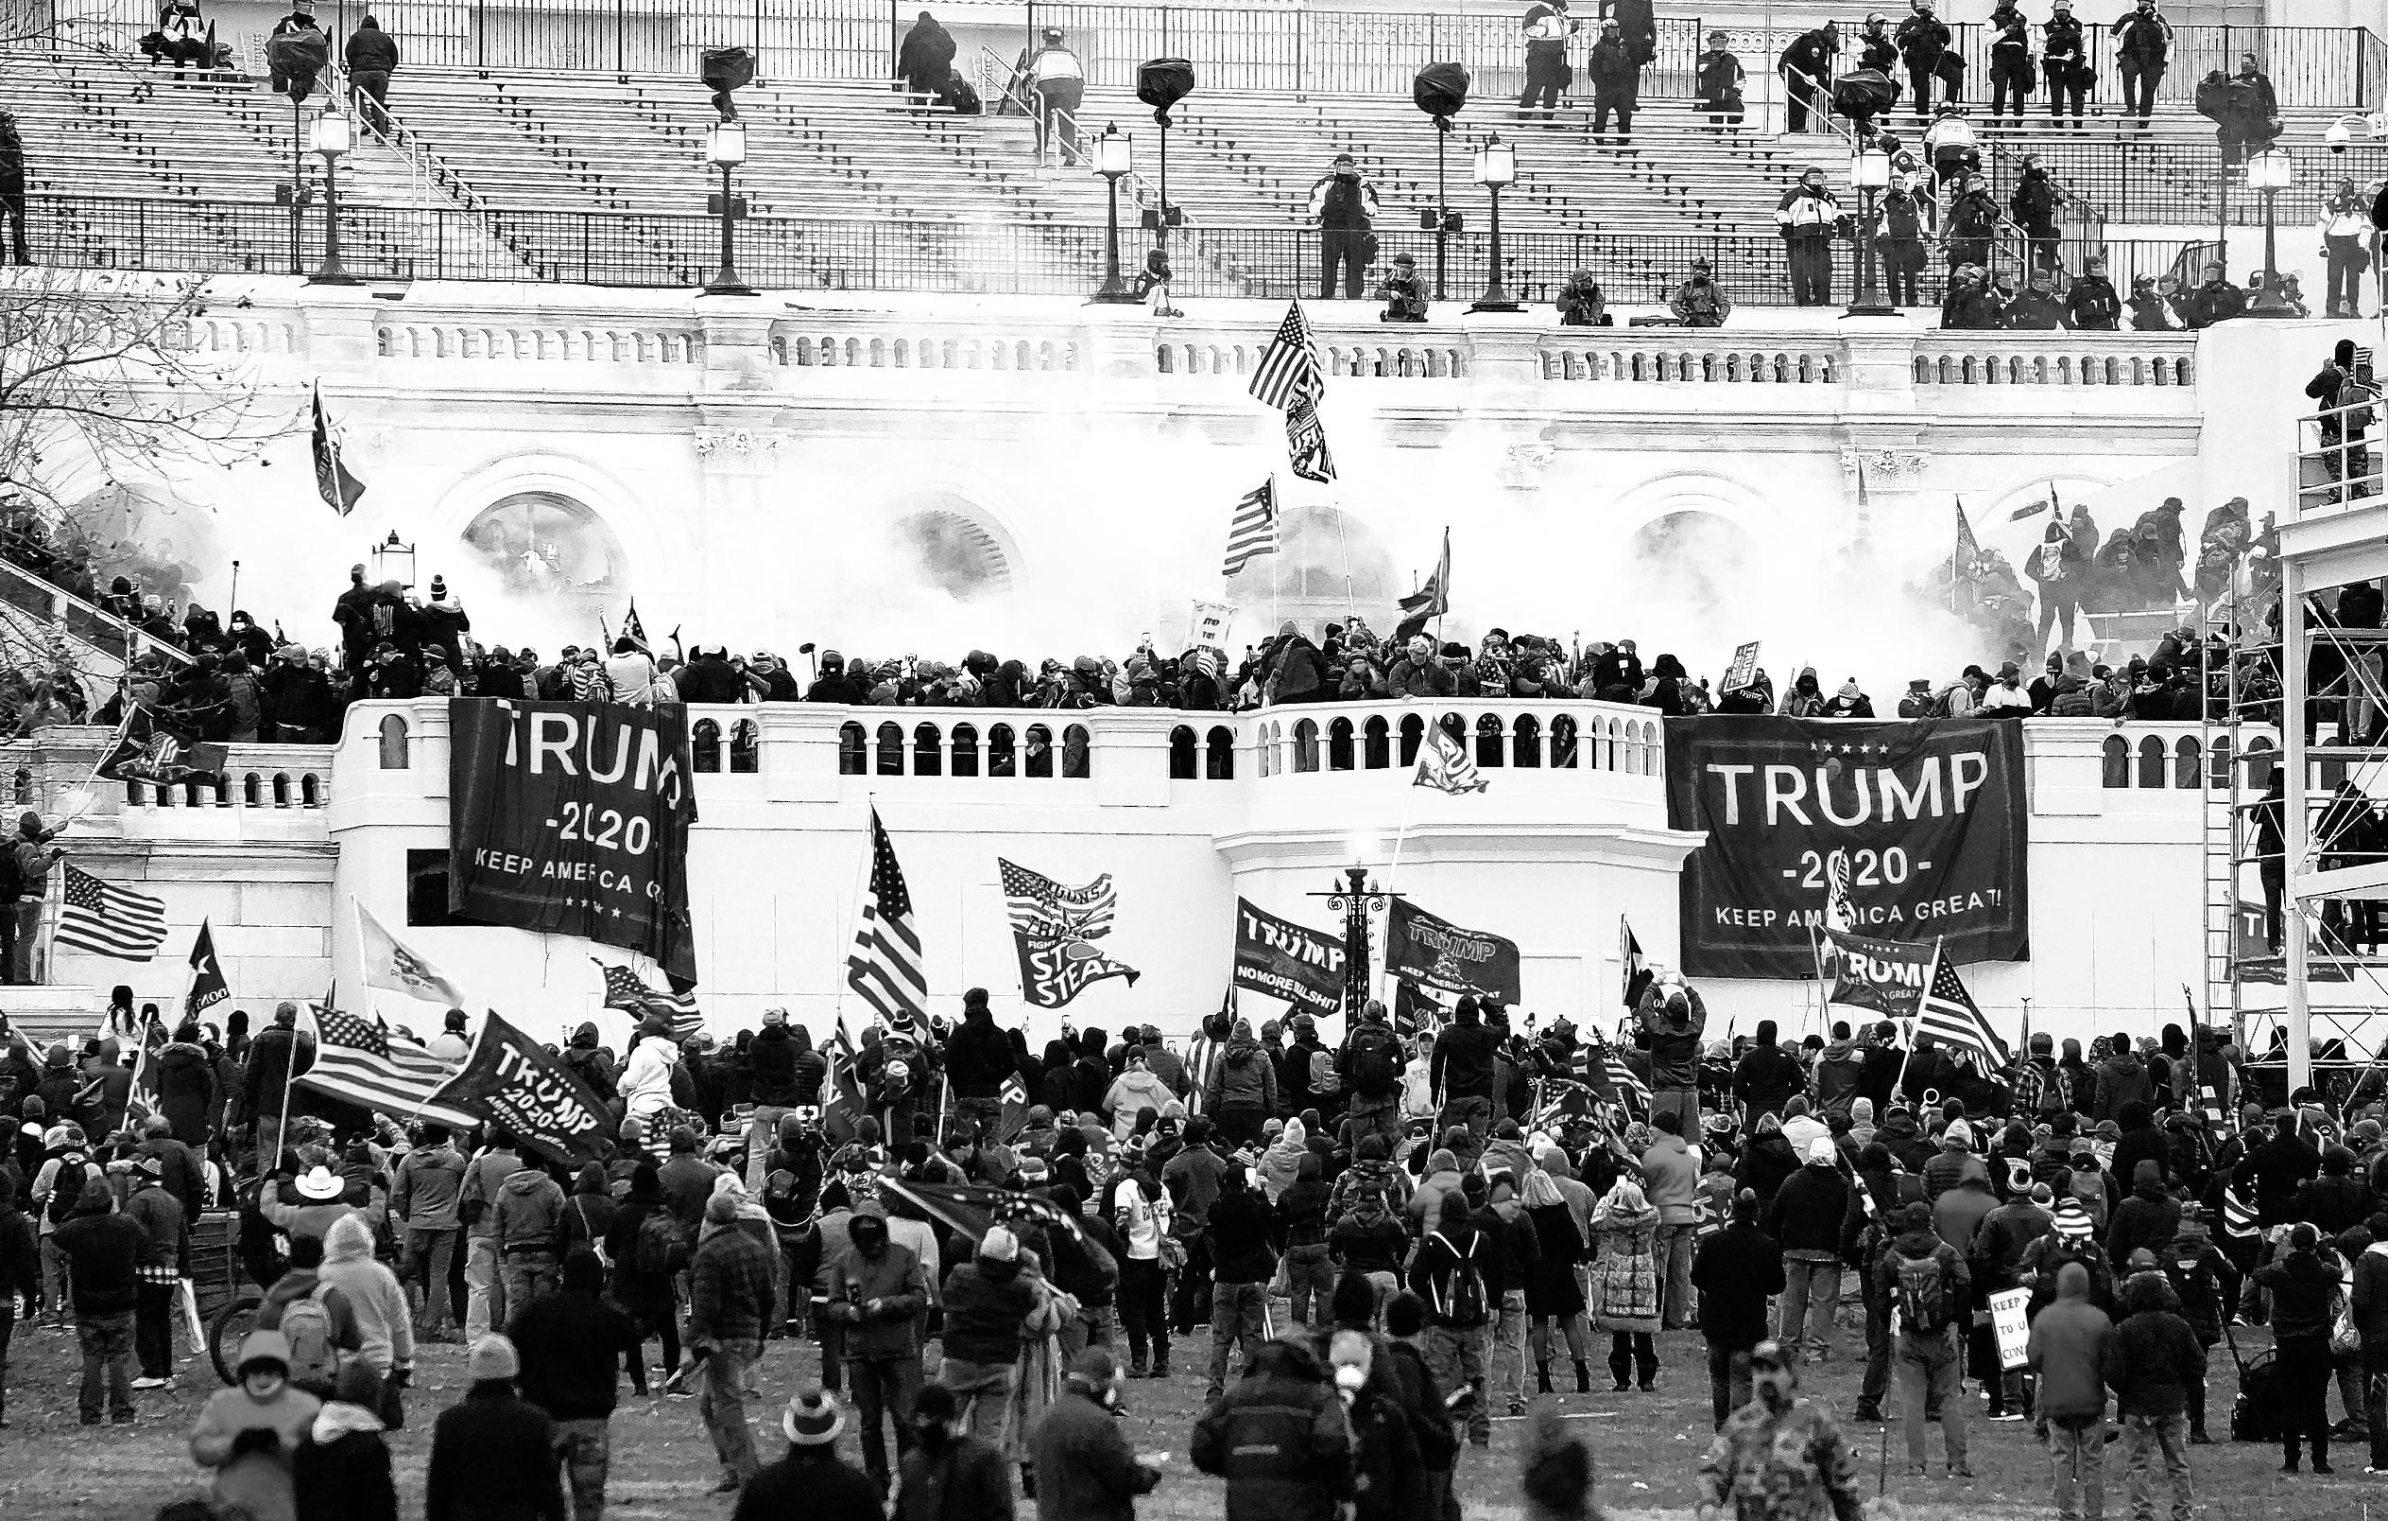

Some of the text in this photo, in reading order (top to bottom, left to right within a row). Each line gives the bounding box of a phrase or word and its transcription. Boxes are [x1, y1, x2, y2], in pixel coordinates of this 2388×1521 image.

[1706, 751, 1989, 827] TRUMP
[474, 847, 533, 875] KEEP
[541, 860, 633, 893] AMECA
[1715, 889, 2002, 928] KEEP AMICA GREAT!
[1242, 910, 1347, 973] TRUMP
[1407, 921, 1496, 962] TRUMP
[1035, 959, 1125, 1006] STEAL
[1400, 965, 1425, 978] KEEP
[1426, 974, 1469, 990] AMERICA
[1838, 948, 1930, 987] RUM
[1889, 990, 1916, 1000] GREAT
[496, 1041, 598, 1135] TRUMP
[1992, 1297, 2020, 1312] KEEP
[1998, 1324, 2014, 1335] TO
